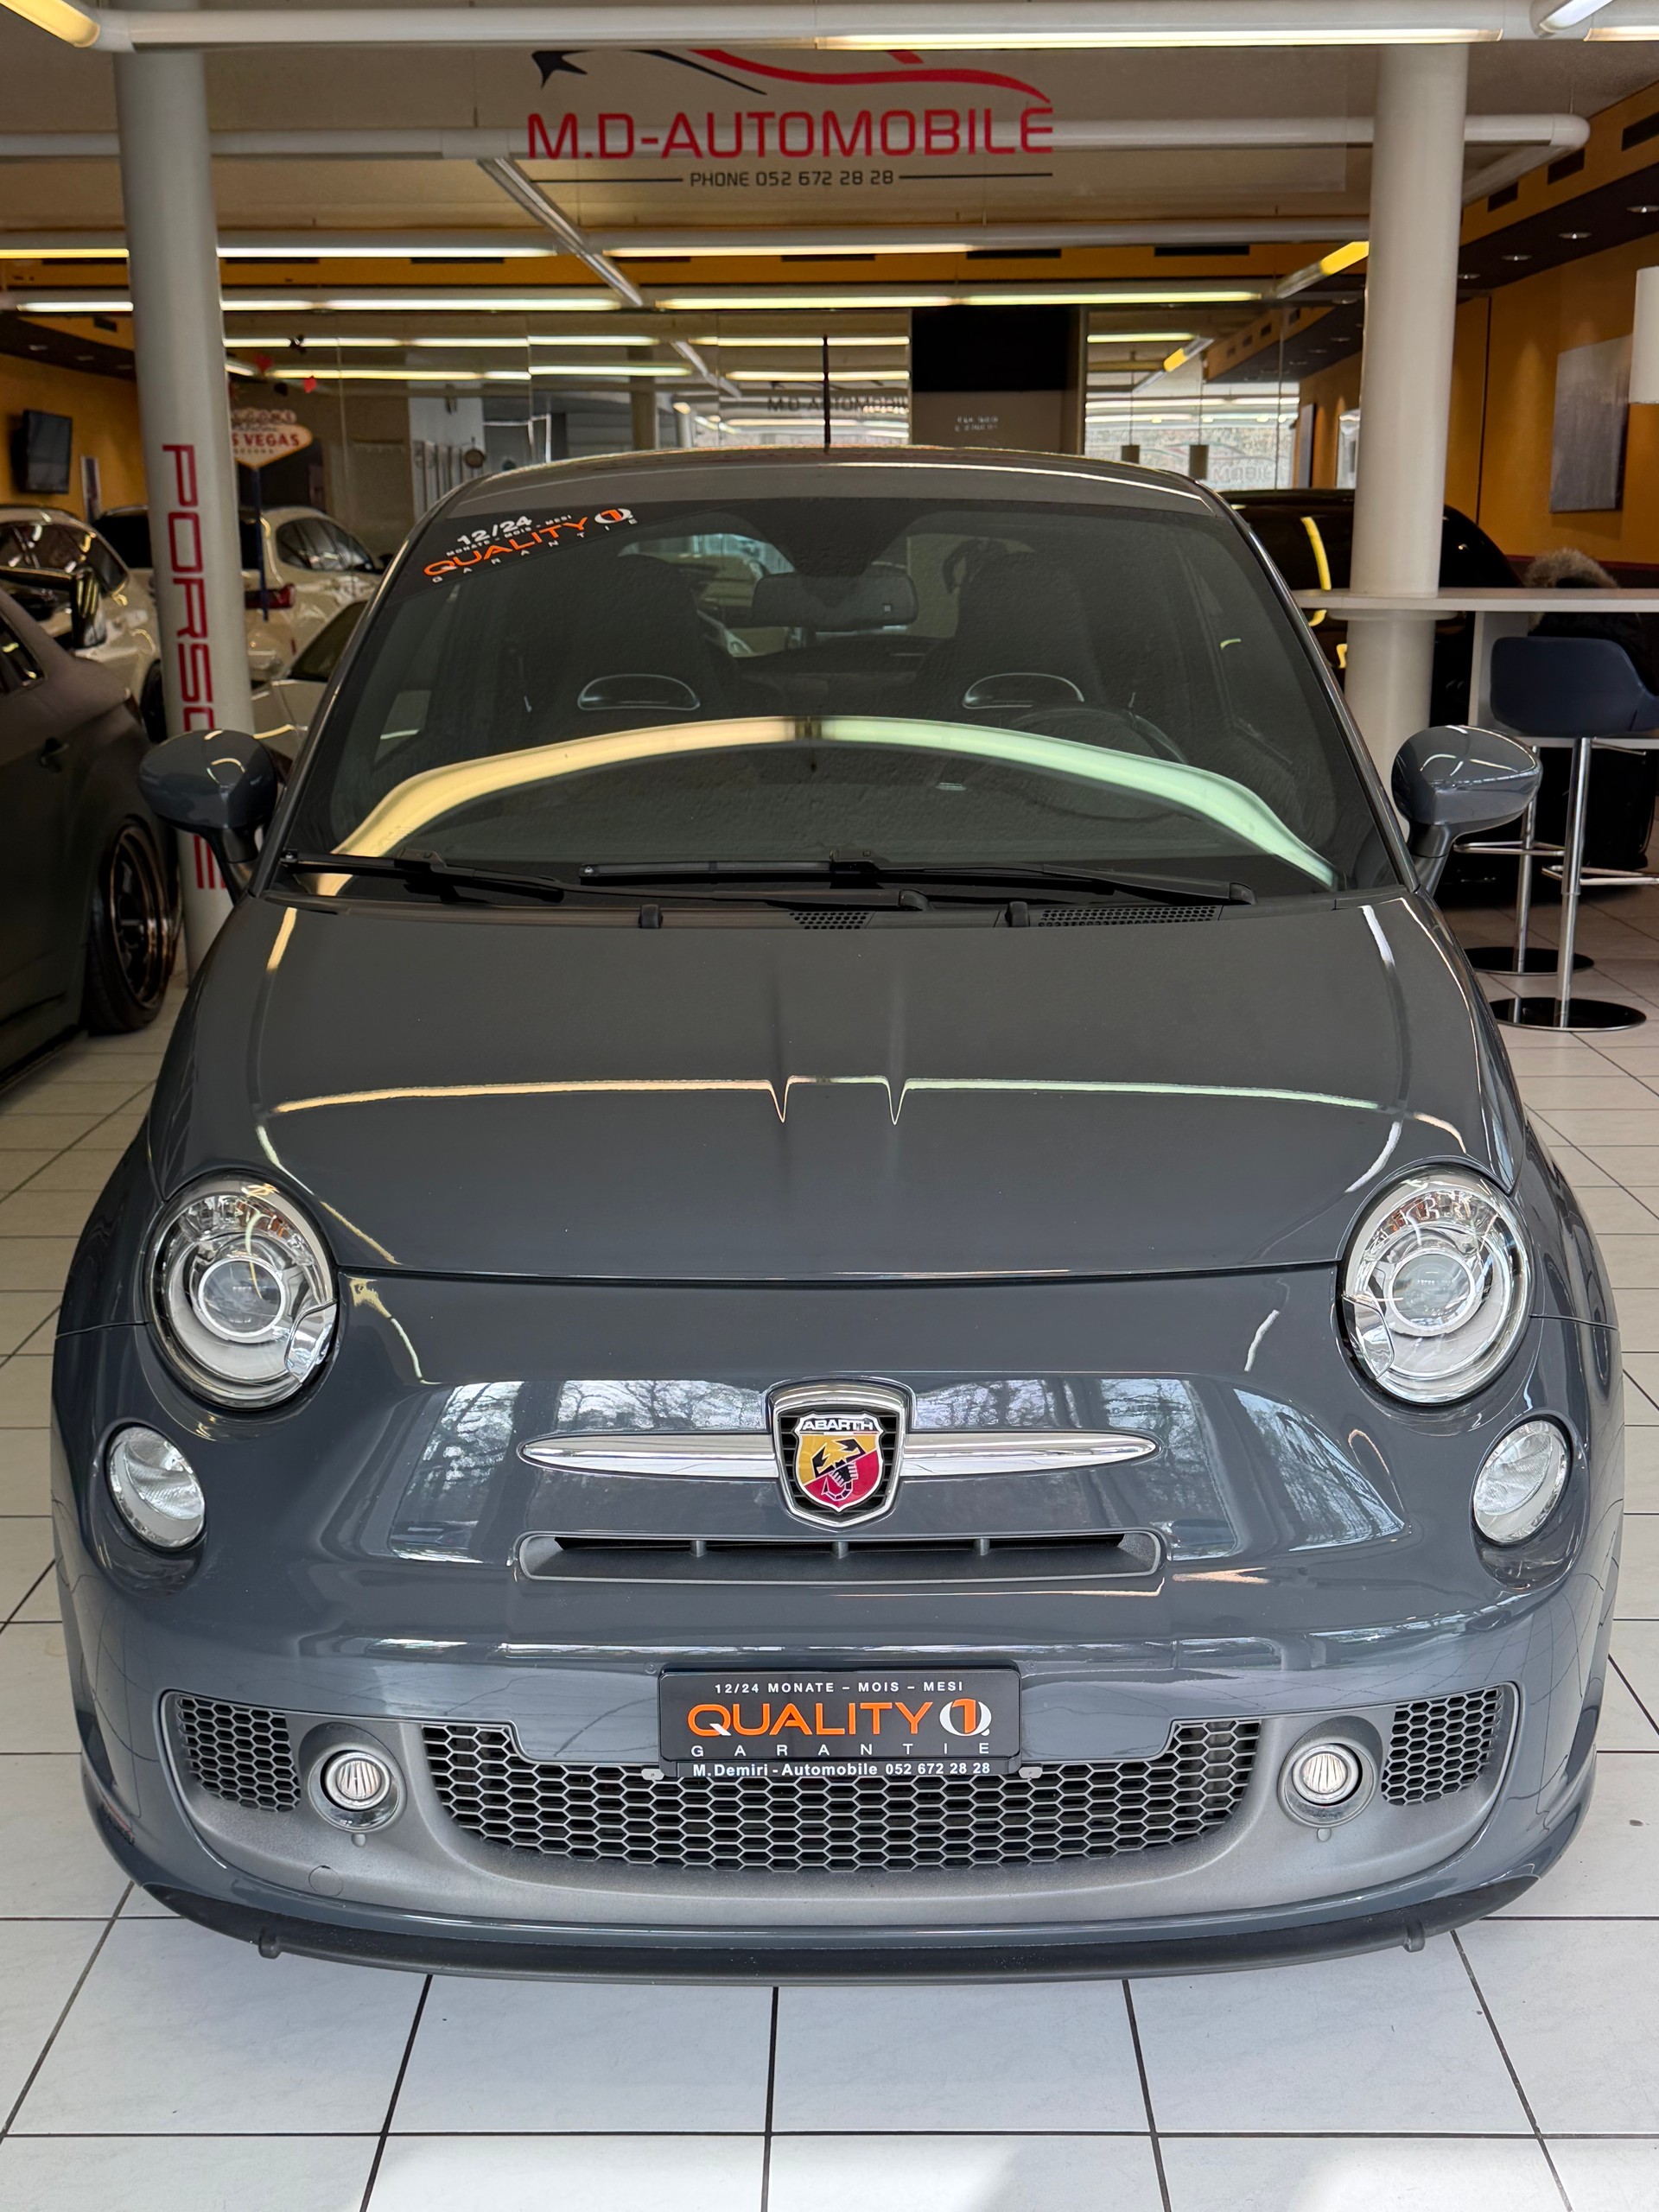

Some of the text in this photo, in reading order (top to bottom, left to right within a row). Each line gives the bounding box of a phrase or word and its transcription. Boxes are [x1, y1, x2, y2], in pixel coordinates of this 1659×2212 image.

[527, 106, 1053, 160] M.D-AUTOMOBILE
[690, 169, 894, 188] PHONE 052 672 28 28
[244, 433, 299, 447] VEGAS
[457, 516, 532, 545] 12/24
[423, 517, 588, 576] QUALITY
[802, 1419, 874, 1431] ABARTH
[715, 1683, 760, 1694] 12/24
[767, 1681, 835, 1694] MONATE
[858, 1681, 899, 1693] MOIS
[923, 1681, 963, 1692] MESI
[687, 1701, 933, 1736] QUALITY
[690, 1742, 989, 1757] GARANTIE
[692, 1764, 769, 1777] M.Demiri
[781, 1763, 878, 1777] Automobile
[885, 1763, 912, 1775] 052
[917, 1763, 944, 1775] 672
[949, 1763, 967, 1774] 28
[972, 1762, 991, 1774] 28
